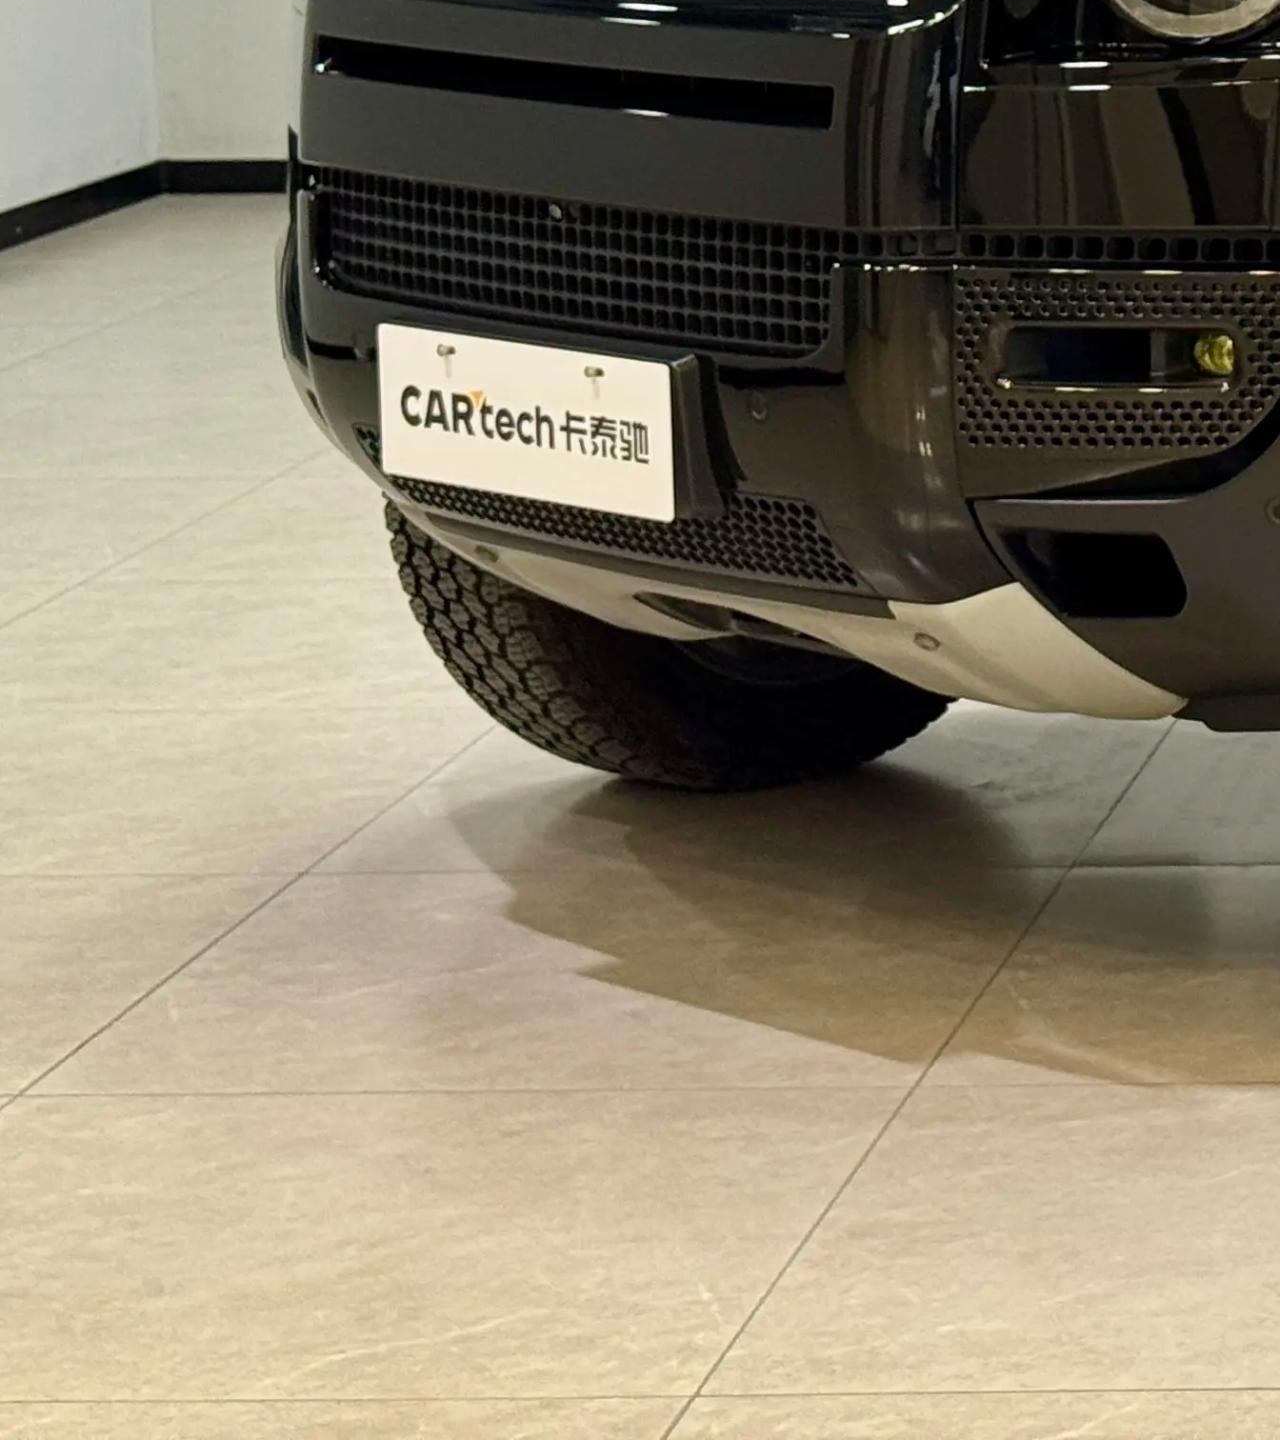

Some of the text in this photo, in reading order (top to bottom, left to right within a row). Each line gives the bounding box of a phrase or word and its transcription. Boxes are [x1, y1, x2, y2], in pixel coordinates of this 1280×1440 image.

[401, 385, 649, 464] CARtech 卡泰驰
